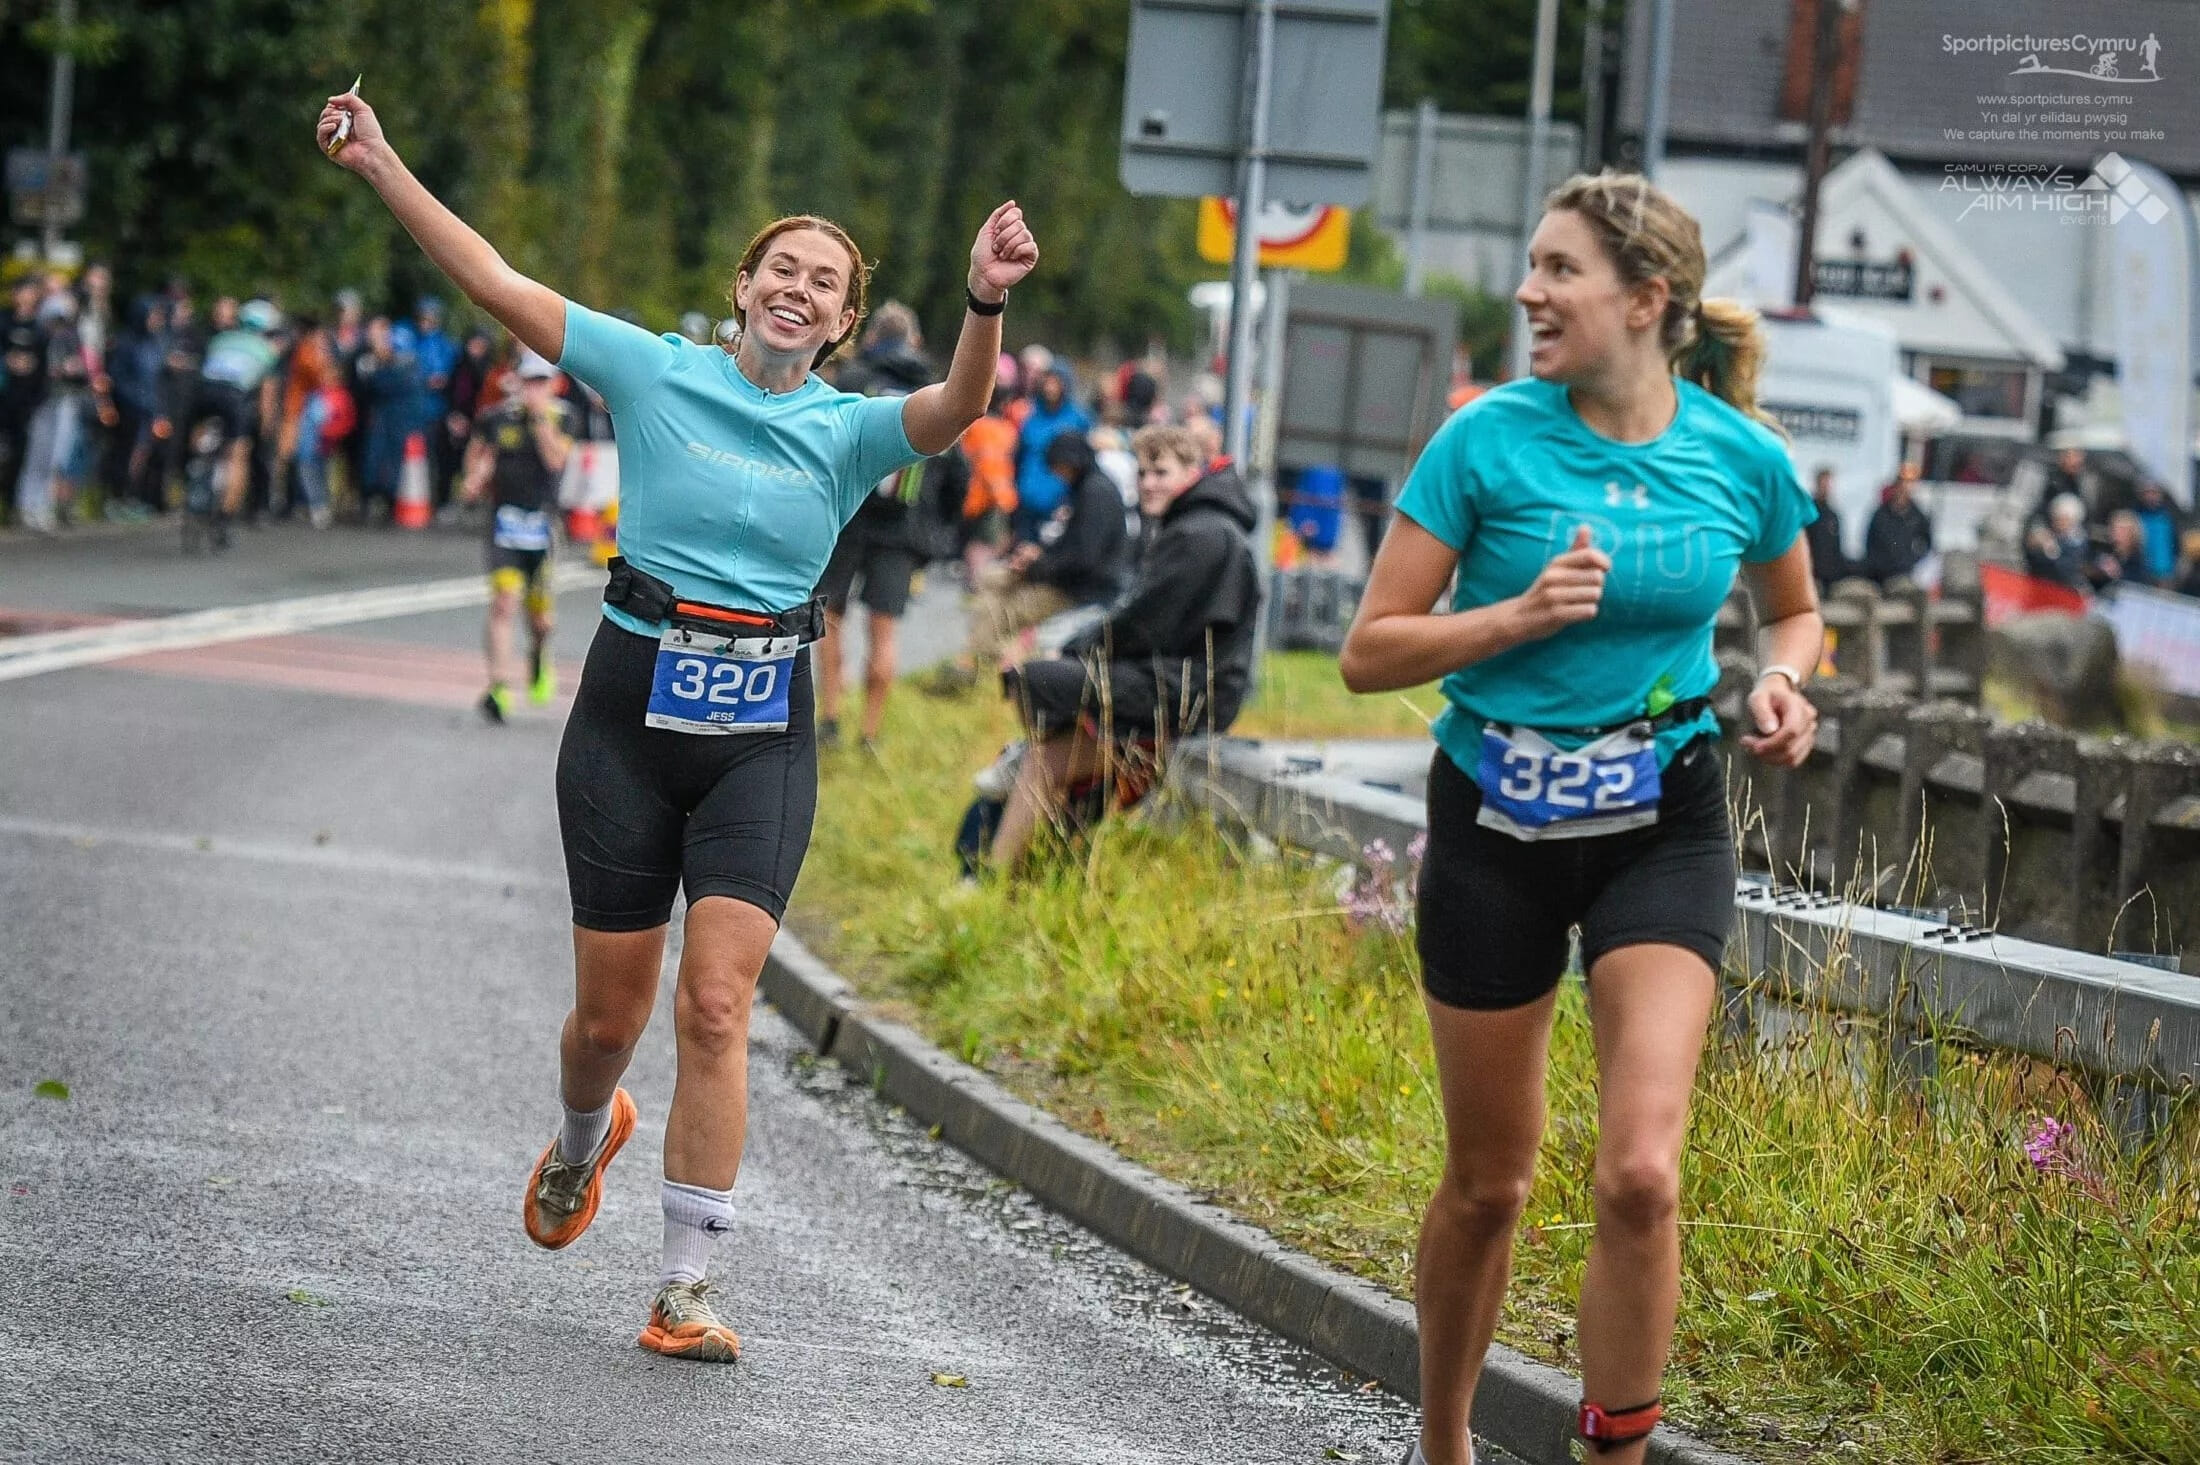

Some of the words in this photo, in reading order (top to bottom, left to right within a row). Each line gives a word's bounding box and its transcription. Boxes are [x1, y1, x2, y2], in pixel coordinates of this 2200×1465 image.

[671, 658, 777, 705] 320
[706, 711, 735, 722] JESS
[1499, 747, 1636, 809] 322
